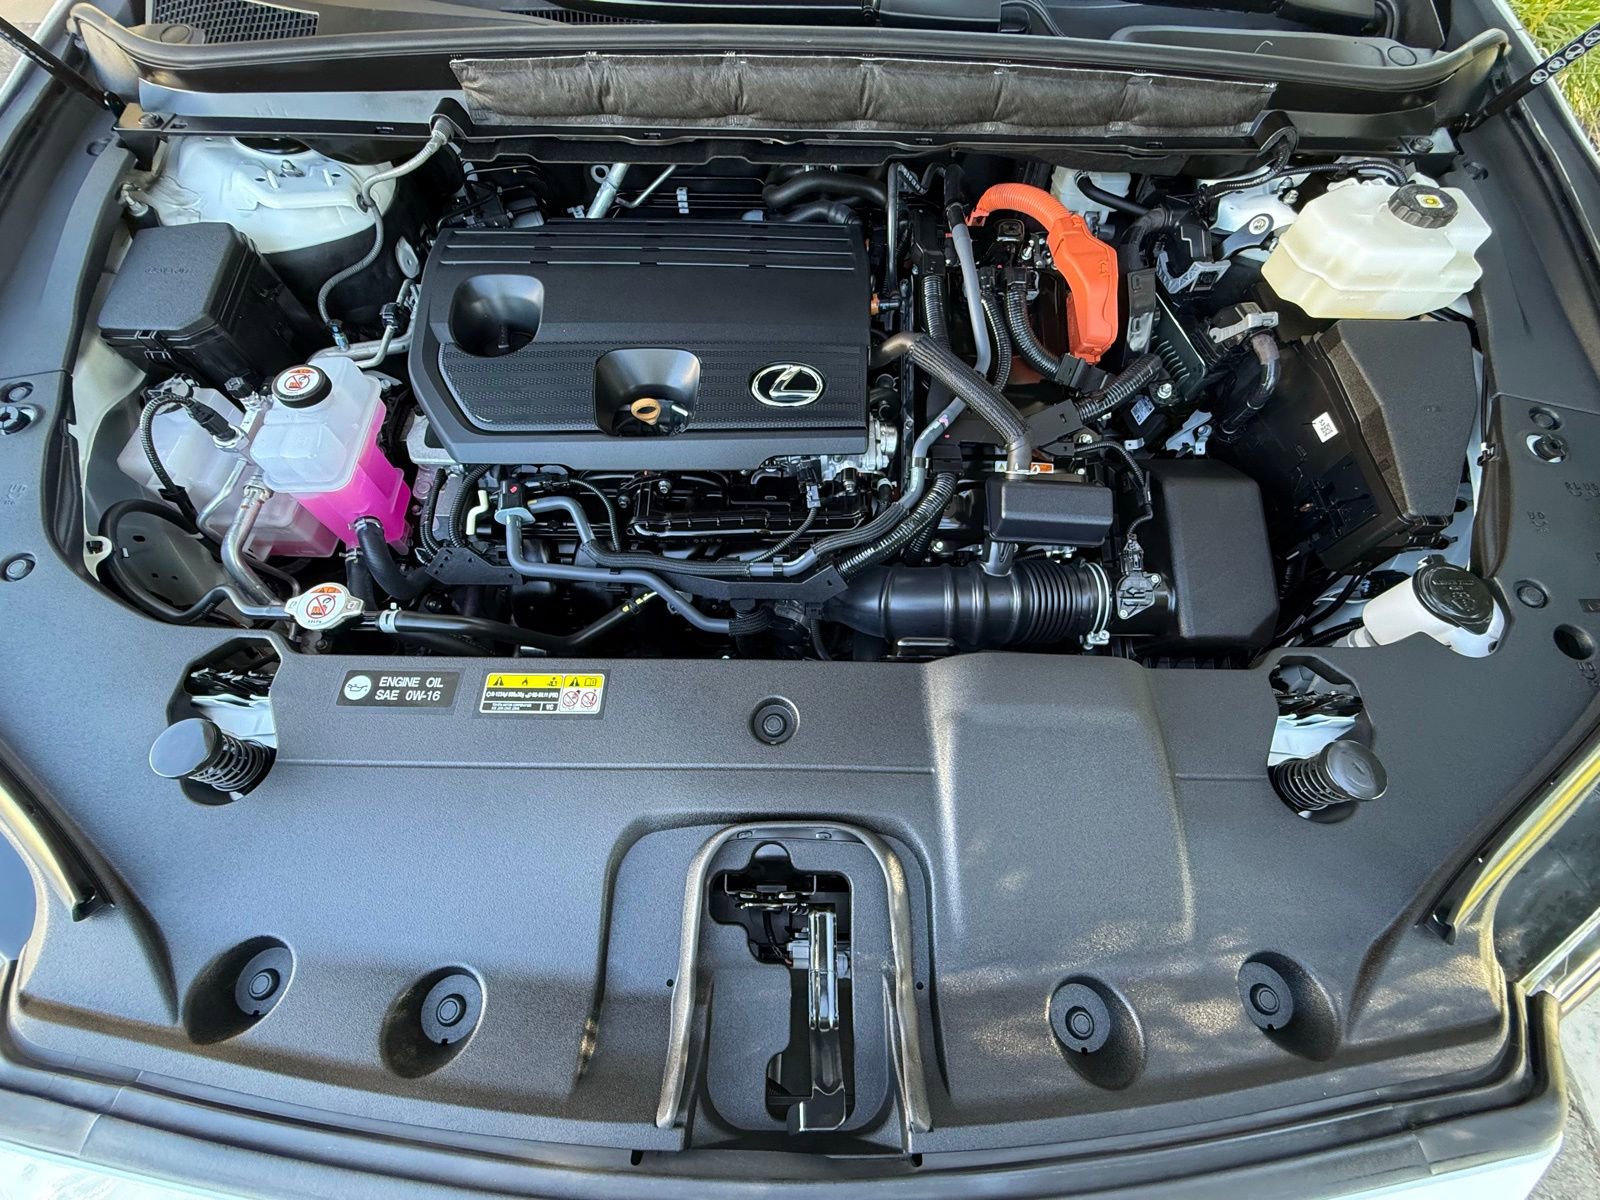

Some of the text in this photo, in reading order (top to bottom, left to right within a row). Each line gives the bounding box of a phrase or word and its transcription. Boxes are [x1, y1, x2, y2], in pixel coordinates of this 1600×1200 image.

[379, 677, 443, 688] ENGINE OIL
[375, 690, 440, 701] SAE 0W-16
